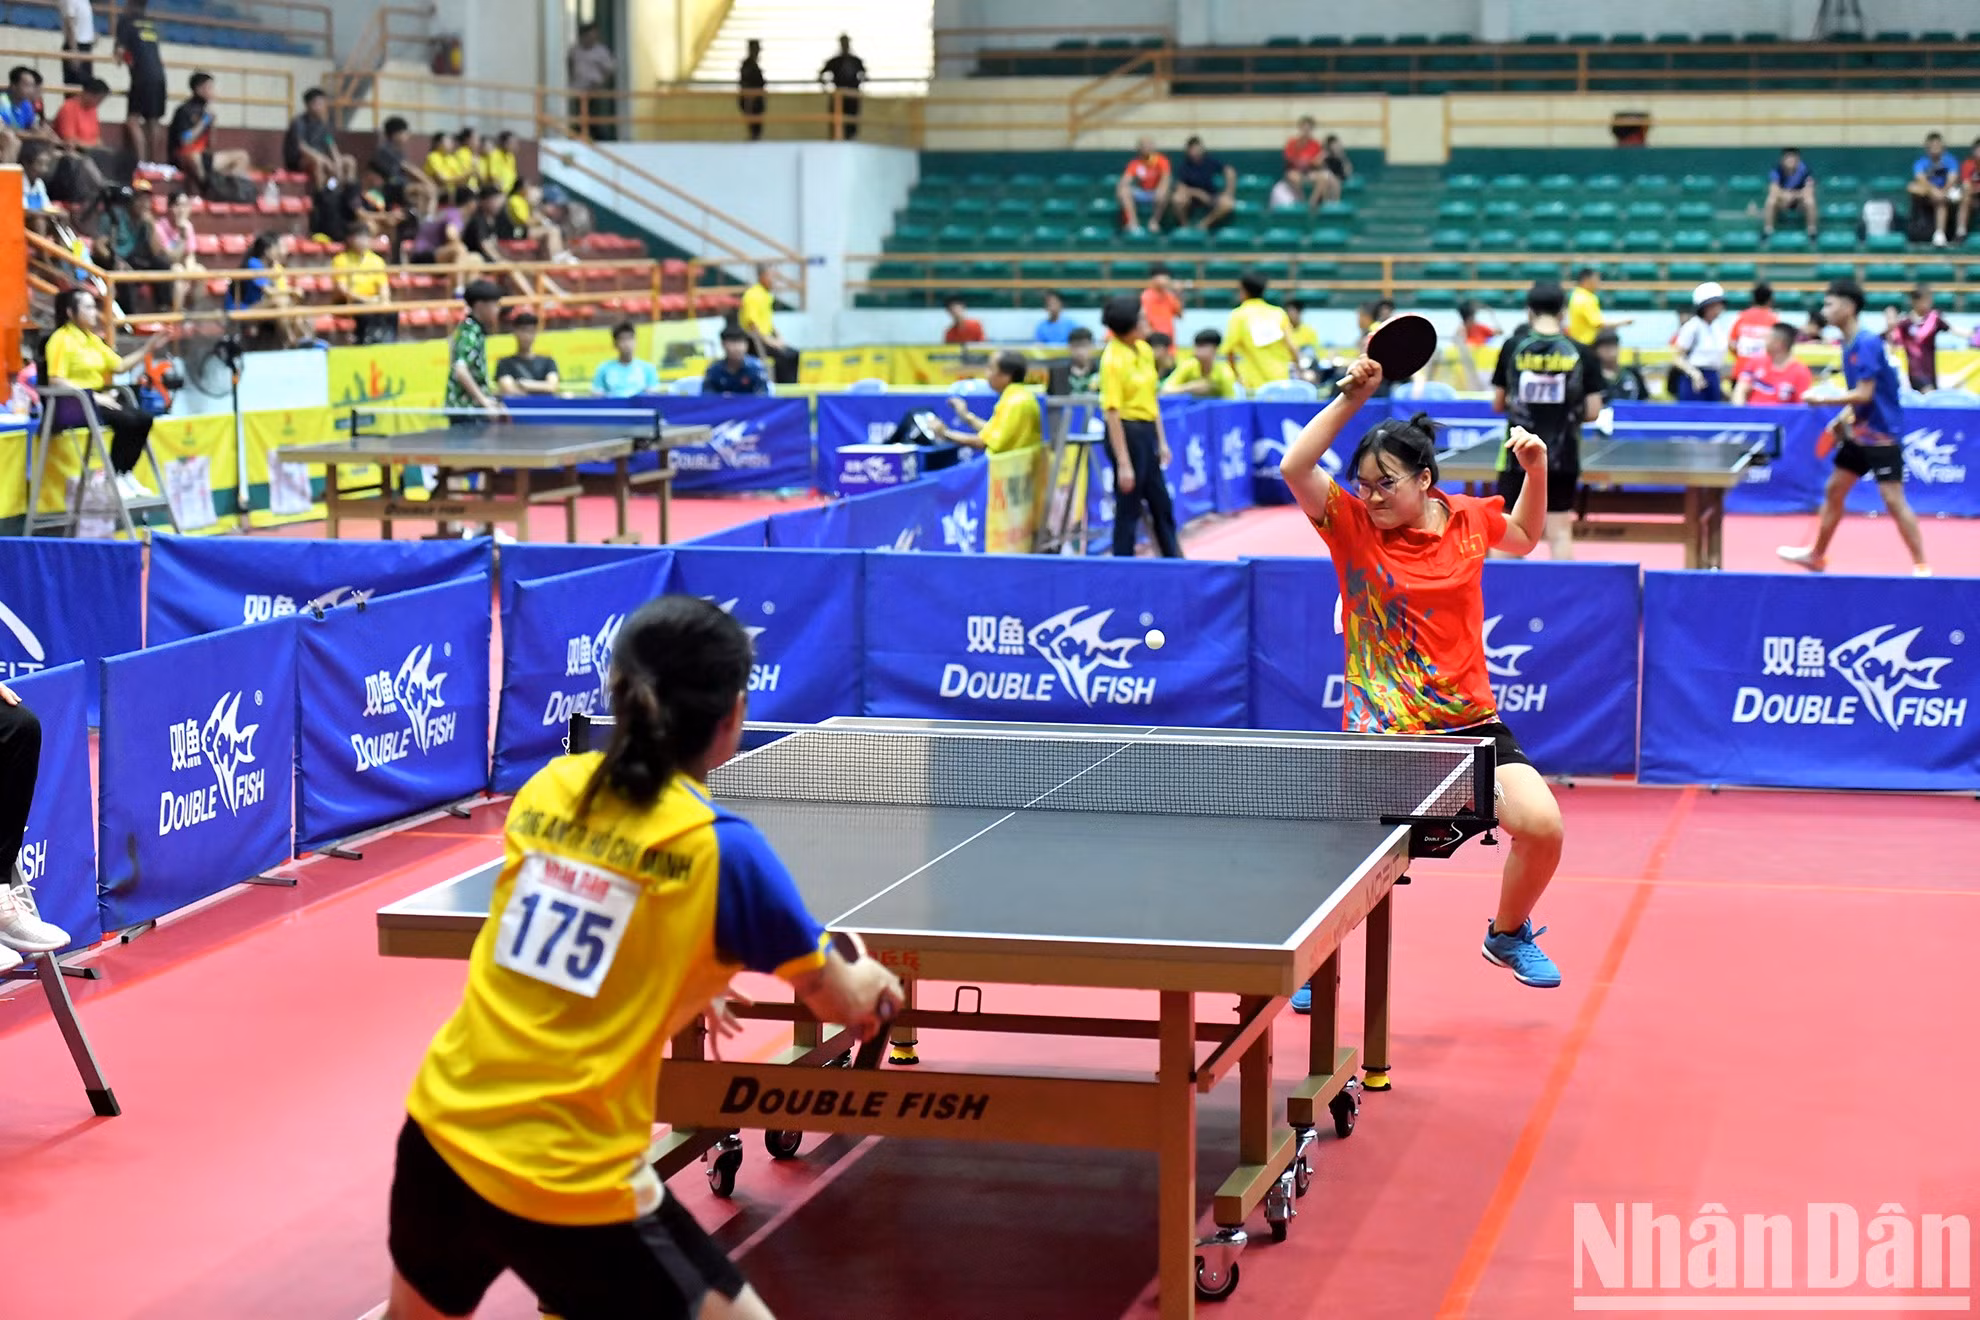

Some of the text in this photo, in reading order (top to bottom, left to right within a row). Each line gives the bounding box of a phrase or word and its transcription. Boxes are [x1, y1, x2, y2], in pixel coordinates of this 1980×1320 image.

[0, 661, 45, 680] IT
[746, 664, 781, 692] SH
[939, 663, 1156, 704] DOUBLE FISH
[1731, 686, 1968, 727] DOUBLE FISH
[350, 711, 456, 773] DOUBLE FISH
[159, 768, 265, 836] DOUBLE FISH
[510, 893, 614, 981] 175
[720, 1076, 990, 1121] DOUBLE FISH
